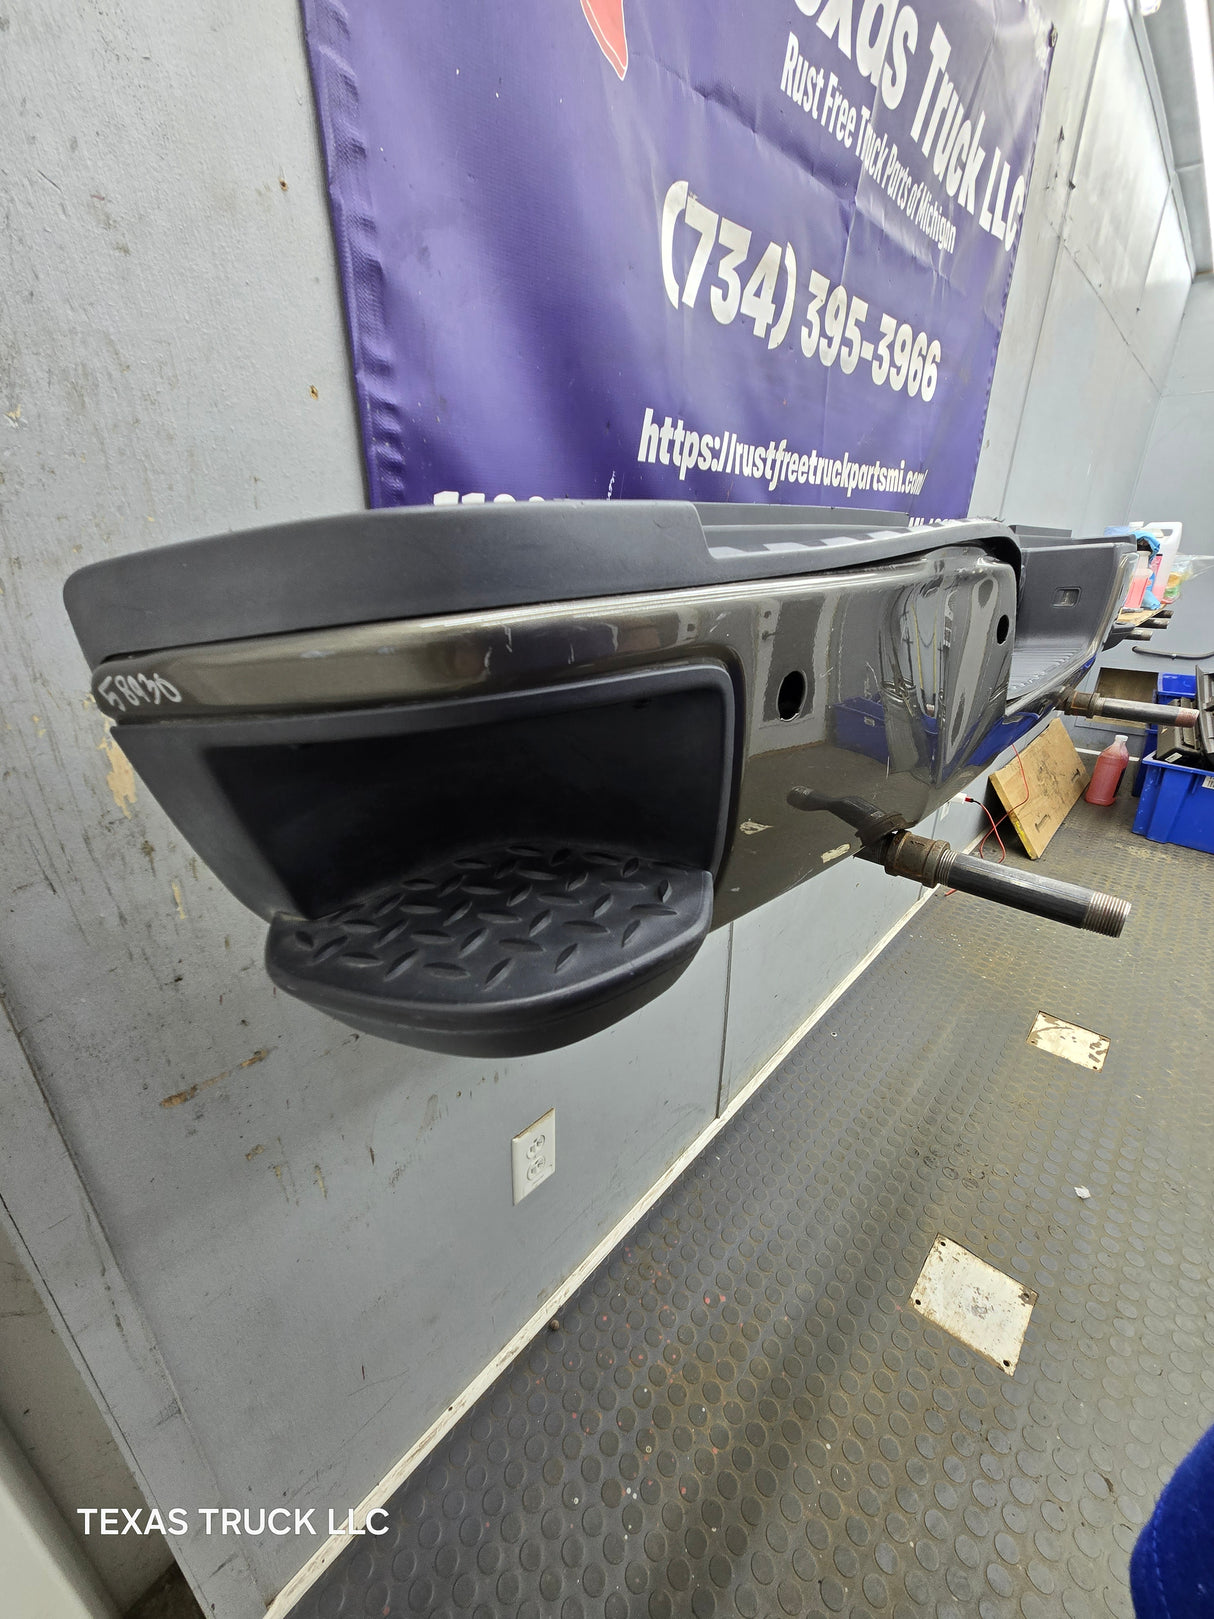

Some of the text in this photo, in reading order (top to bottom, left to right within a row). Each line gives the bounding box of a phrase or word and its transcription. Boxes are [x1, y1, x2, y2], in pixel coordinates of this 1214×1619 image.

[780, 31, 957, 254] Rust Free Truck Parts of Michigan
[794, 0, 1025, 252] xas Truck LLC
[661, 180, 942, 402] (734) 395-3966
